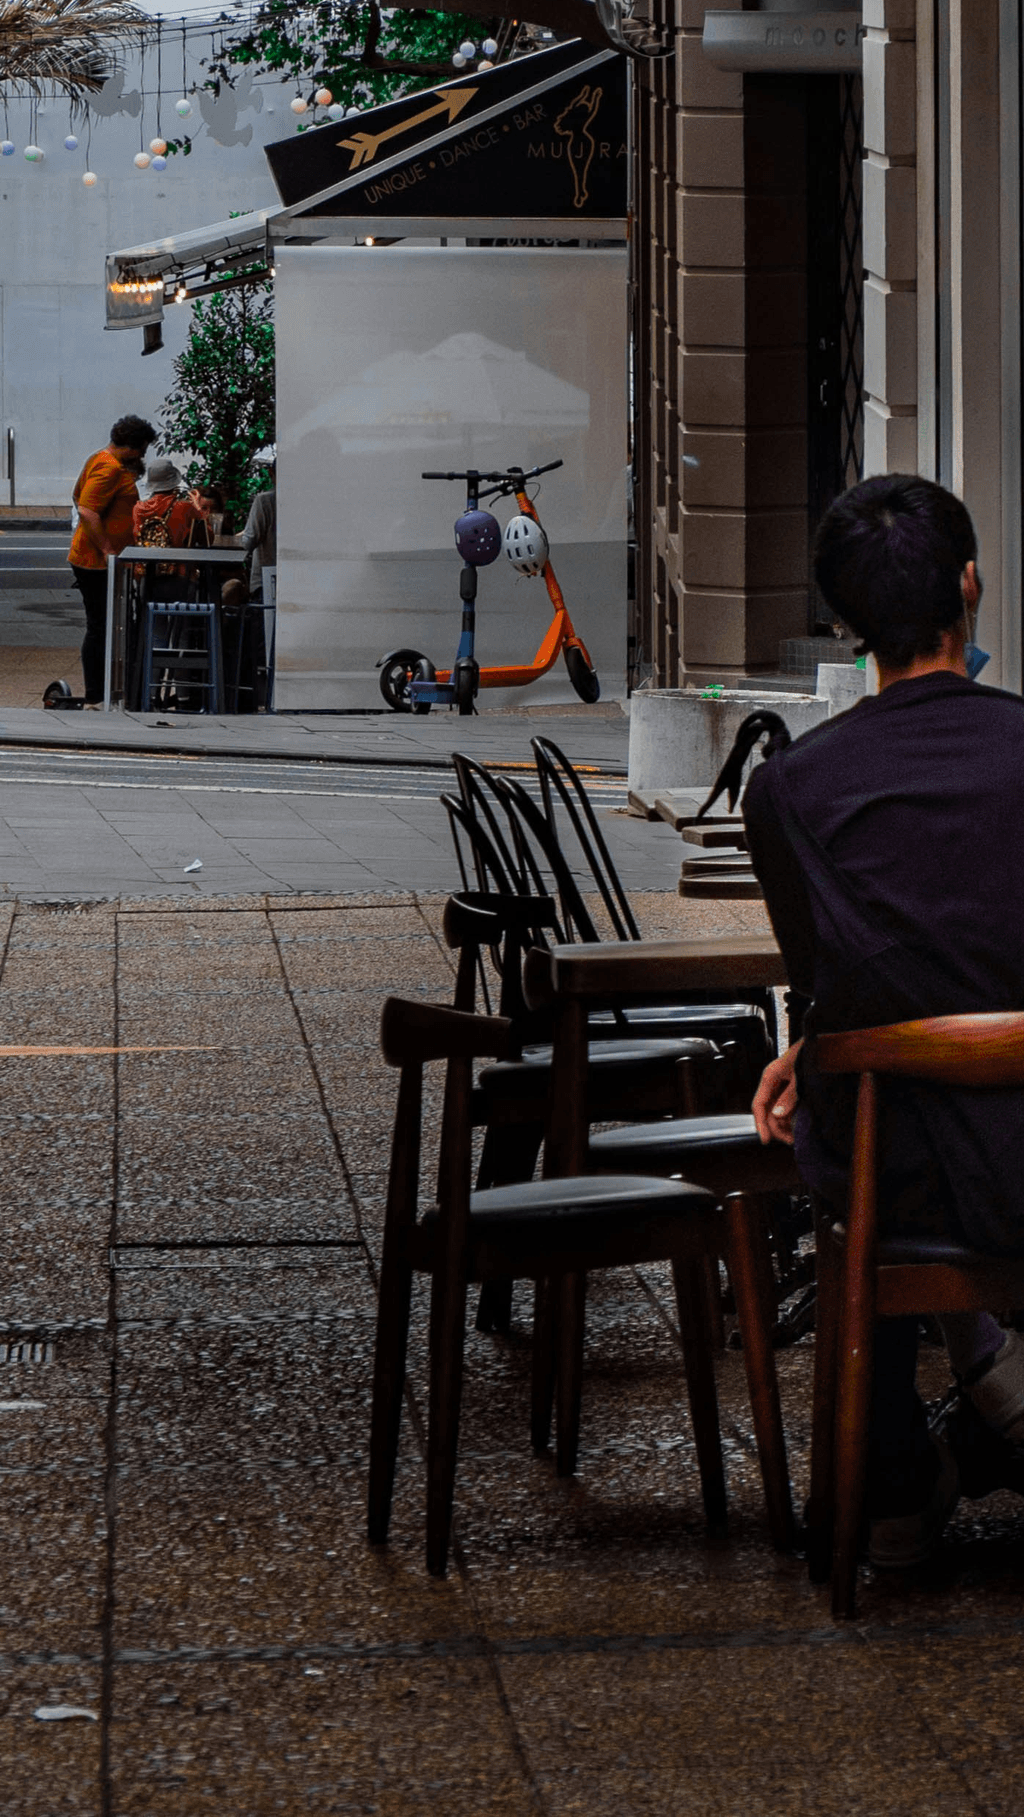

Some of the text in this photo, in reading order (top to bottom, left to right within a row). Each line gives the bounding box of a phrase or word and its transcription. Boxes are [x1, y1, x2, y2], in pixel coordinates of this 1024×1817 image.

[364, 103, 548, 204] UNIQUE DANCE BAR
